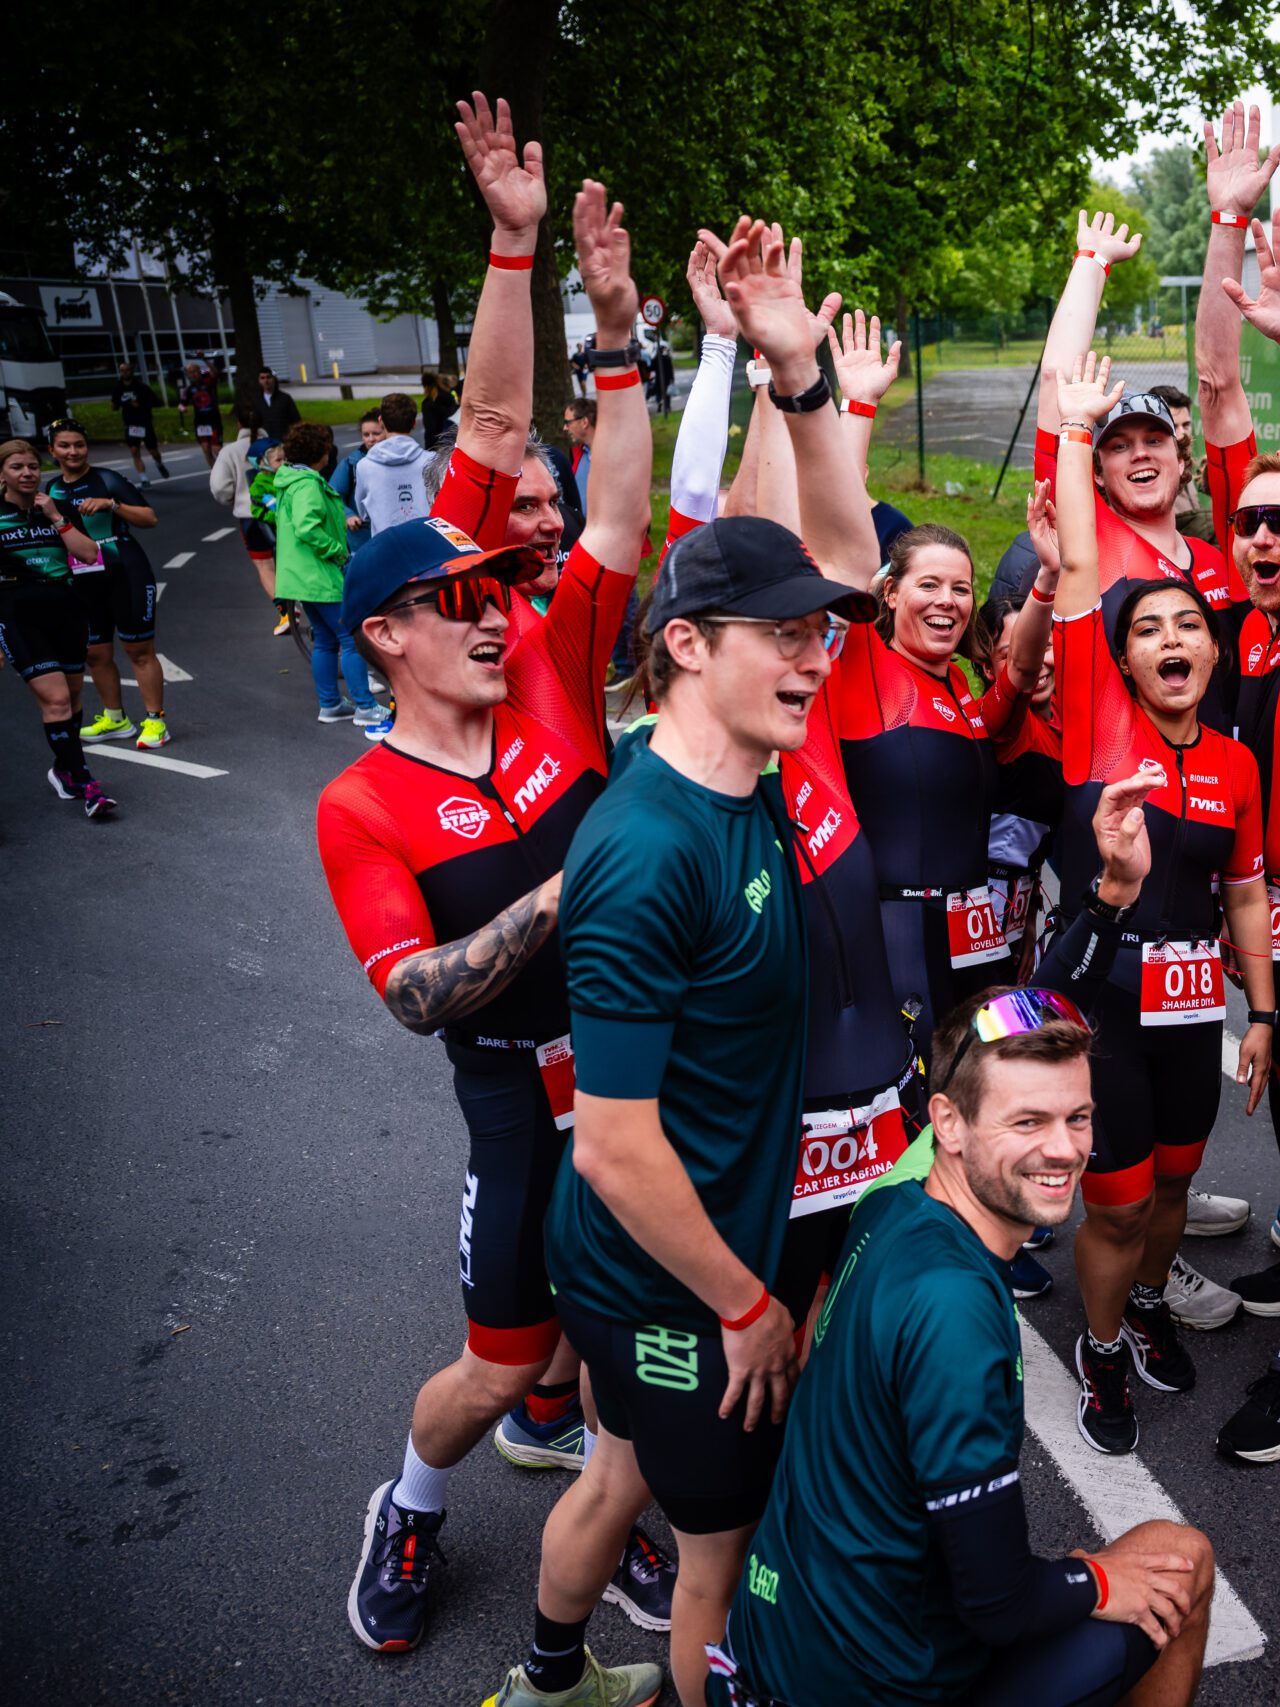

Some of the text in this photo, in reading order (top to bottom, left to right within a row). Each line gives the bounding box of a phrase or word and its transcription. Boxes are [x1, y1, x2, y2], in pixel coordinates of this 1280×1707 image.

[646, 304, 660, 317] 50
[1, 528, 25, 542] nxt
[1189, 774, 1219, 785] BIORACER
[440, 809, 491, 830] STARS
[971, 938, 995, 951] LOVELL
[1165, 962, 1213, 997] 018
[1161, 997, 1215, 1010] SHAHARE DIYA
[802, 1122, 880, 1177] 004
[793, 1160, 894, 1196] CARLIER SABRINA
